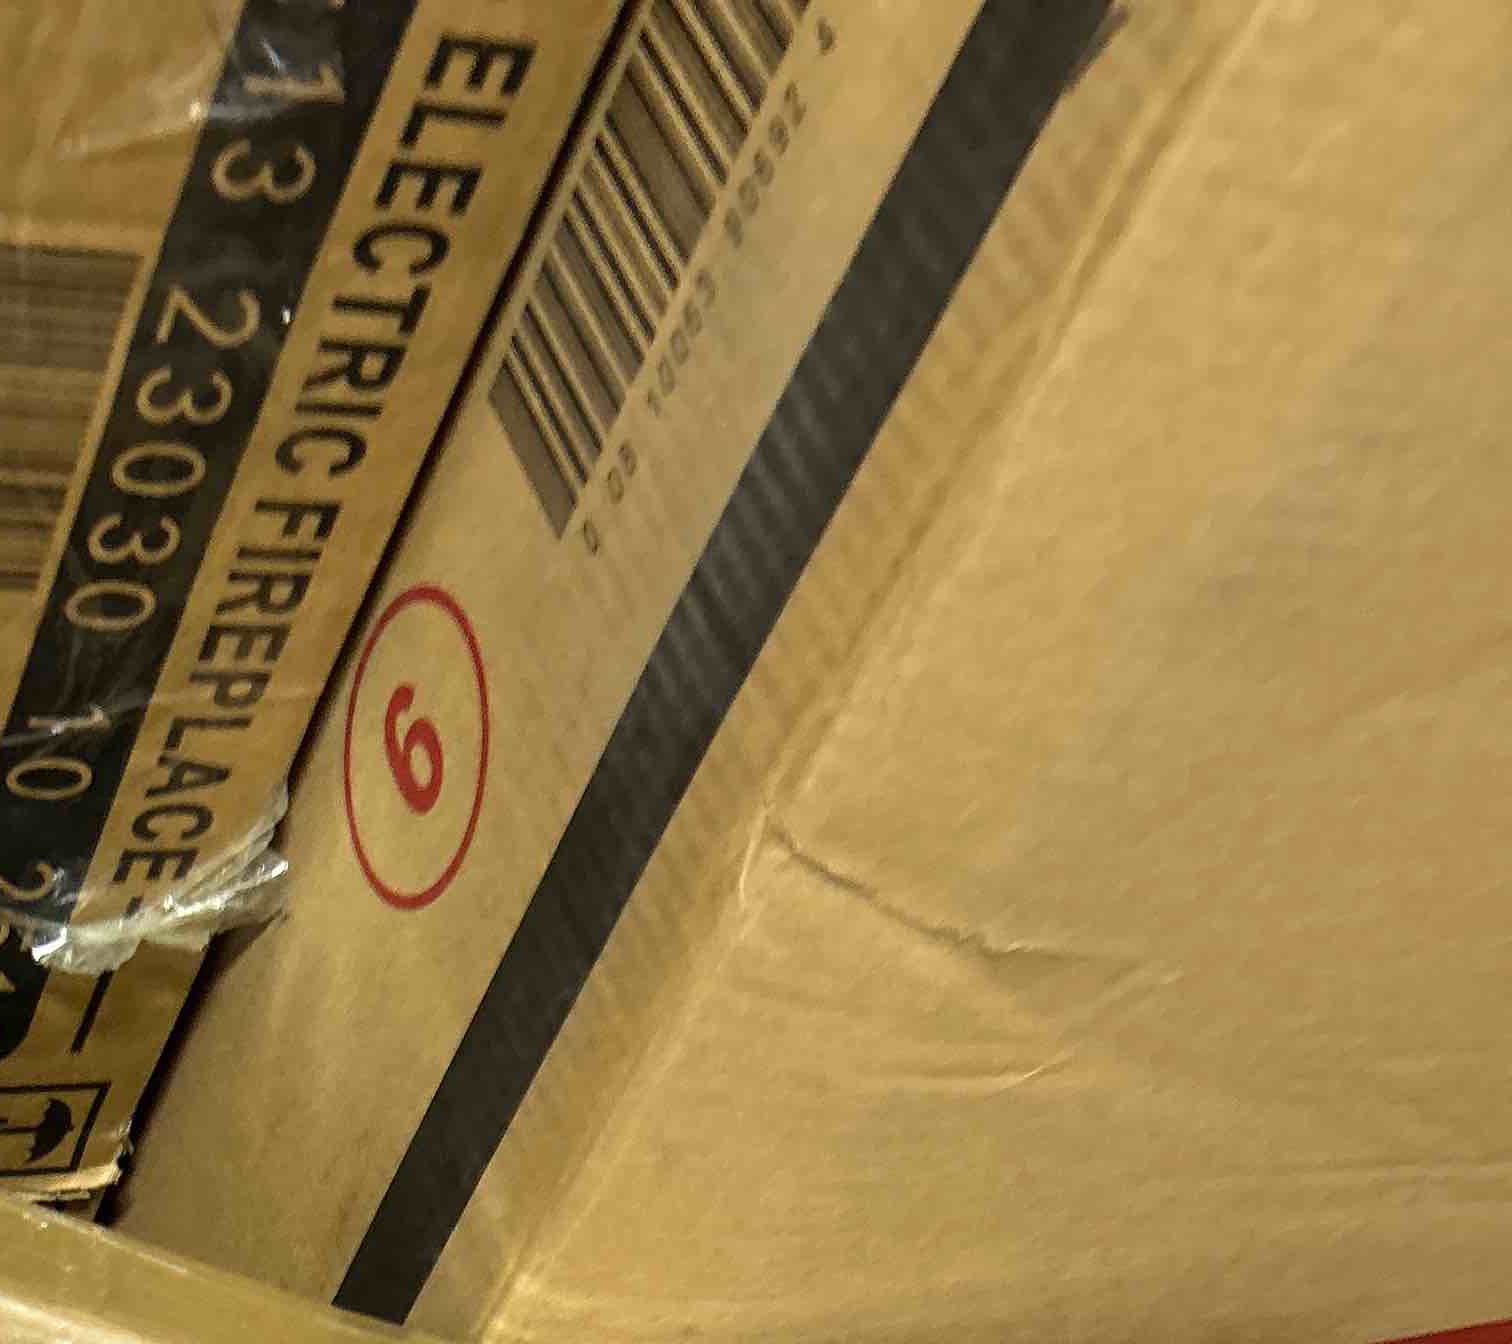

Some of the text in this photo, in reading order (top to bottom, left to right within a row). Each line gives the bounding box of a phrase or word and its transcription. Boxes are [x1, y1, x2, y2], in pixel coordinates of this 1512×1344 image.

[65, 286, 262, 635] 23030
[110, 32, 537, 886] ELECTRIC FIREPLACE
